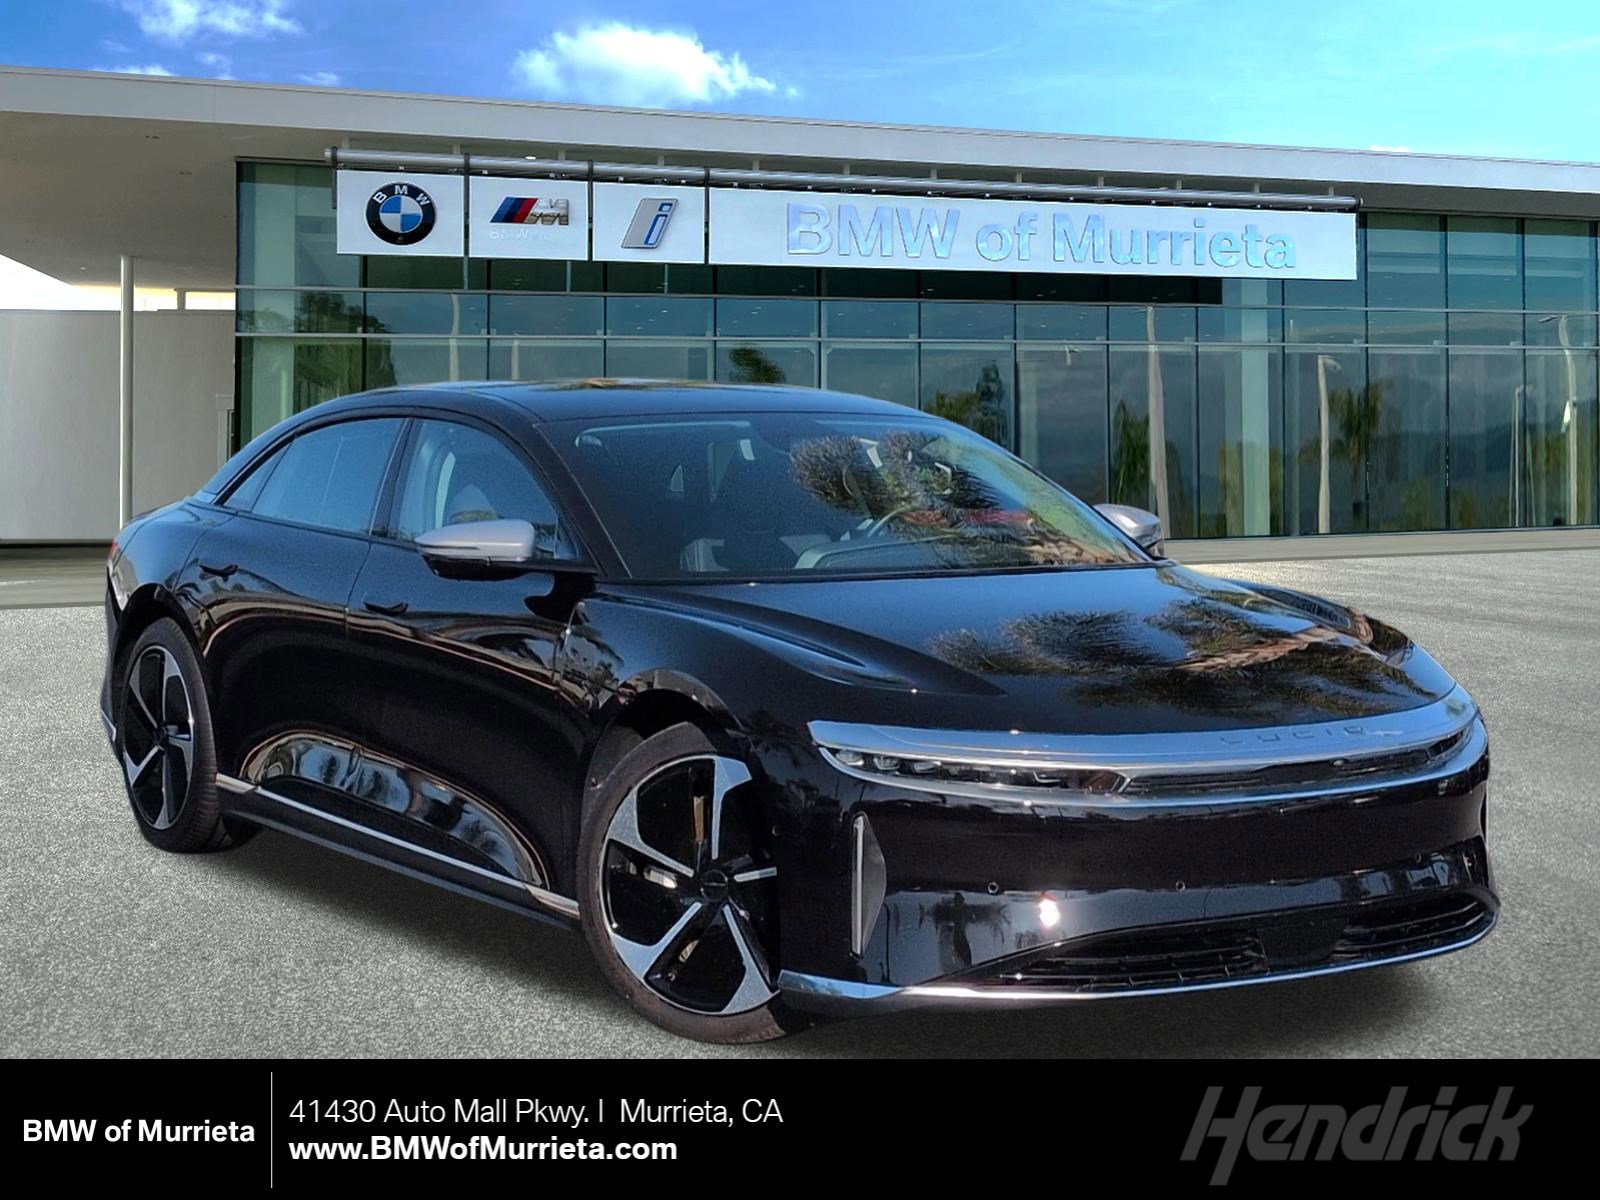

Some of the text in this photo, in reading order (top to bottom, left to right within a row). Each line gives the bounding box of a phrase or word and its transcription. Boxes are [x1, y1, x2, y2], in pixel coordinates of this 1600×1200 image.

[787, 202, 1296, 269] BMW of Murrieta
